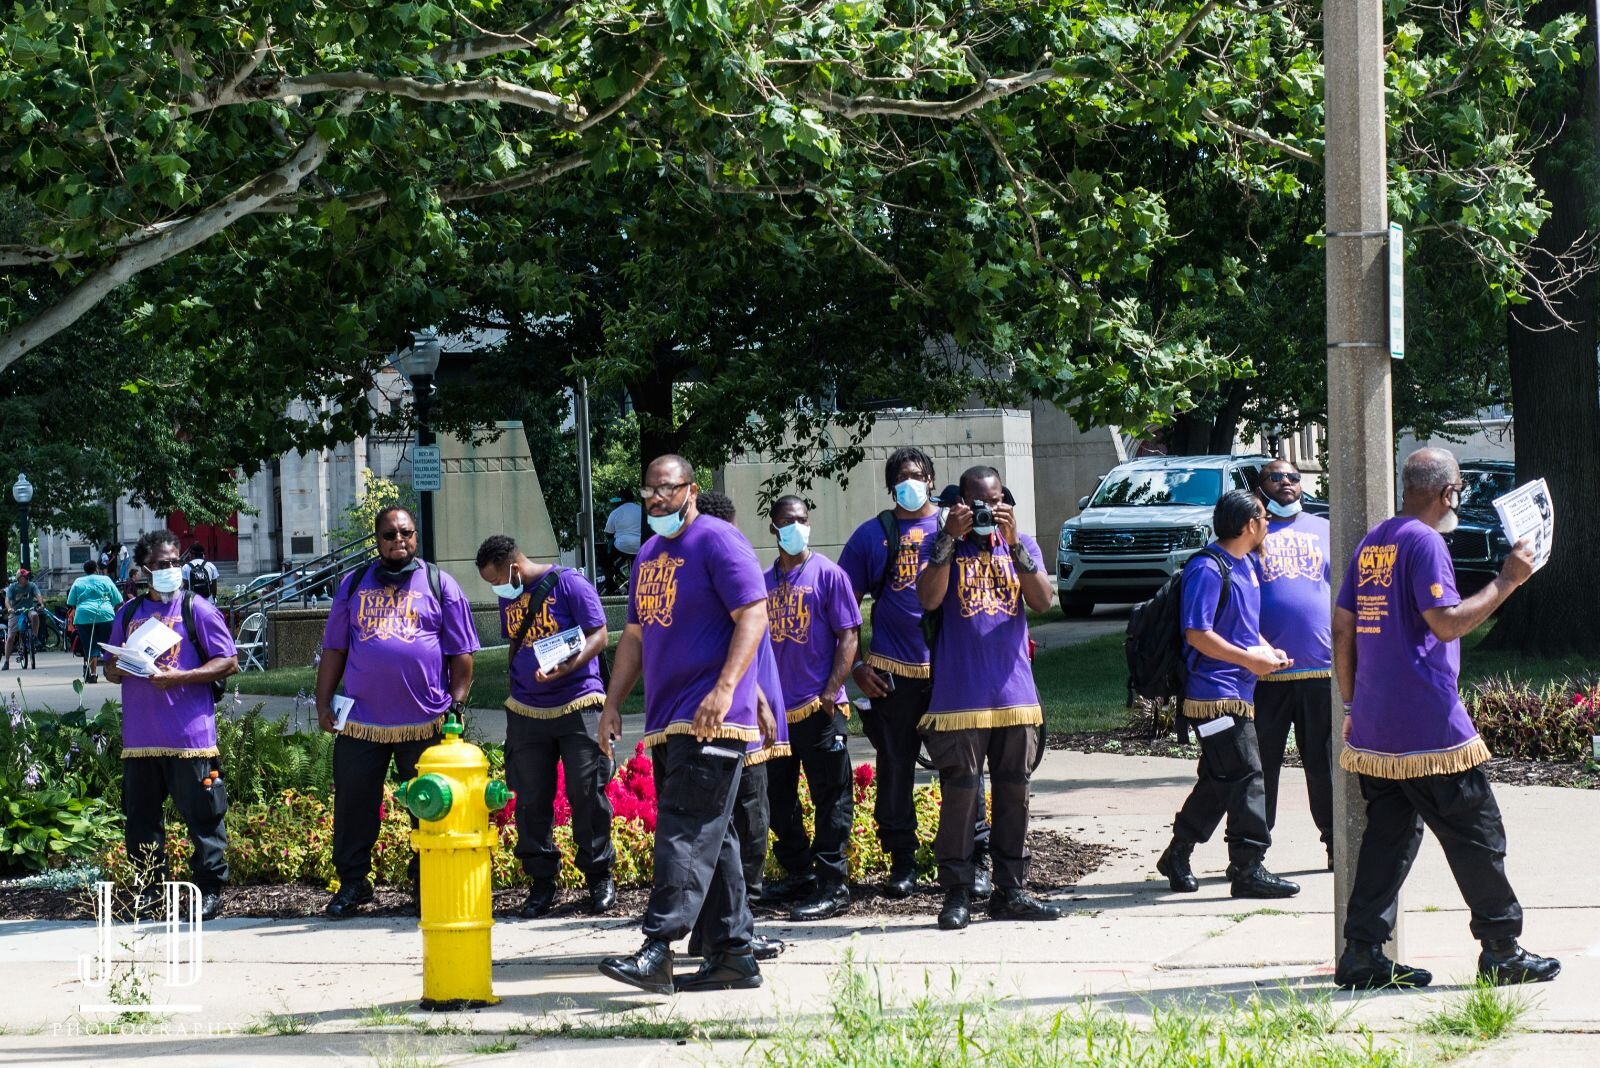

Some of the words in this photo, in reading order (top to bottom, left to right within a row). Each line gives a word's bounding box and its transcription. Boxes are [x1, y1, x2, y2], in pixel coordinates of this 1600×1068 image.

[958, 558, 1020, 587] ISRAEL
[966, 577, 994, 588] UNITED
[959, 586, 1020, 603] CHRIST
[358, 591, 419, 618] ISRAEL
[358, 616, 418, 632] CHRIST
